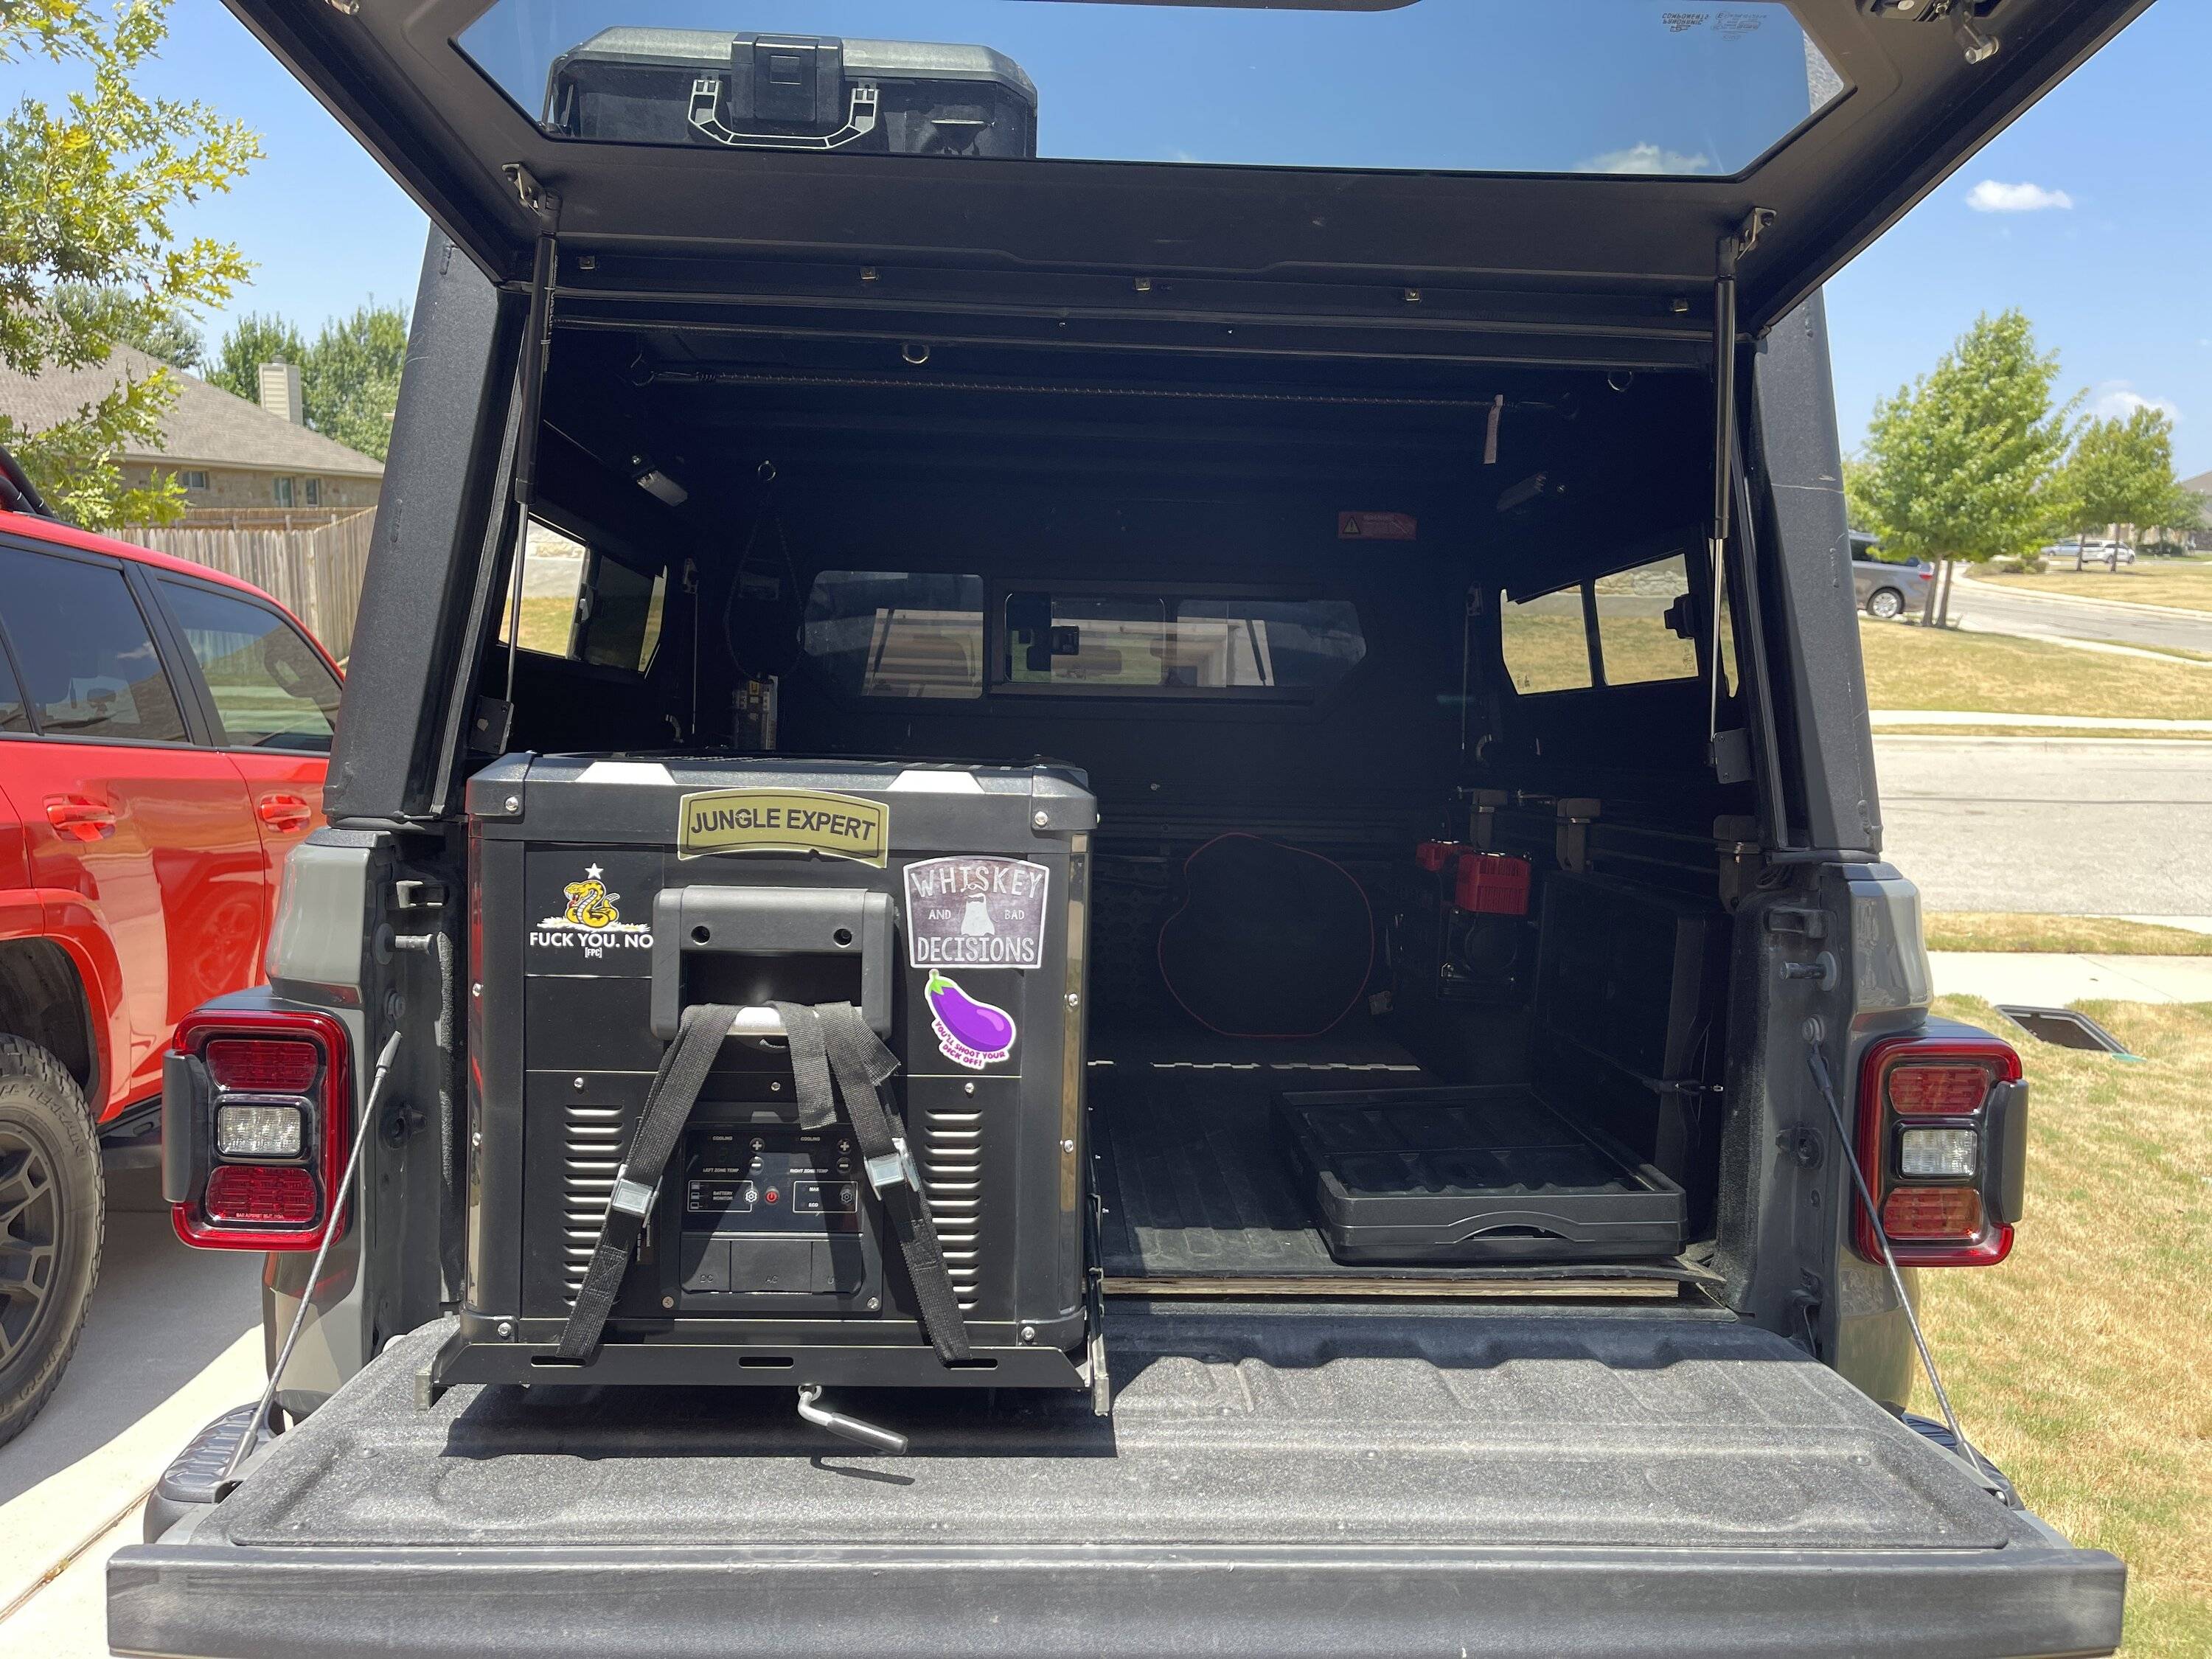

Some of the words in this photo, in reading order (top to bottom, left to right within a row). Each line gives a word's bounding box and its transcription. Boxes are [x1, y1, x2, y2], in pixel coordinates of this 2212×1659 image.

[691, 808, 781, 834] JUNGLE
[787, 809, 876, 841] EXPERT
[911, 866, 1043, 899] WHISKEY
[928, 909, 951, 920] AND
[1004, 909, 1025, 920] BAD
[529, 932, 574, 947] FUCK
[577, 932, 620, 947] YOU.
[625, 933, 654, 948] NO
[917, 936, 1034, 962] DECISIONS
[935, 1020, 953, 1046] YOU'LL
[954, 1043, 981, 1058] SHOOT
[982, 1051, 1006, 1060] YOUR
[942, 1043, 962, 1060] DICK
[963, 1057, 982, 1067] OFF!
